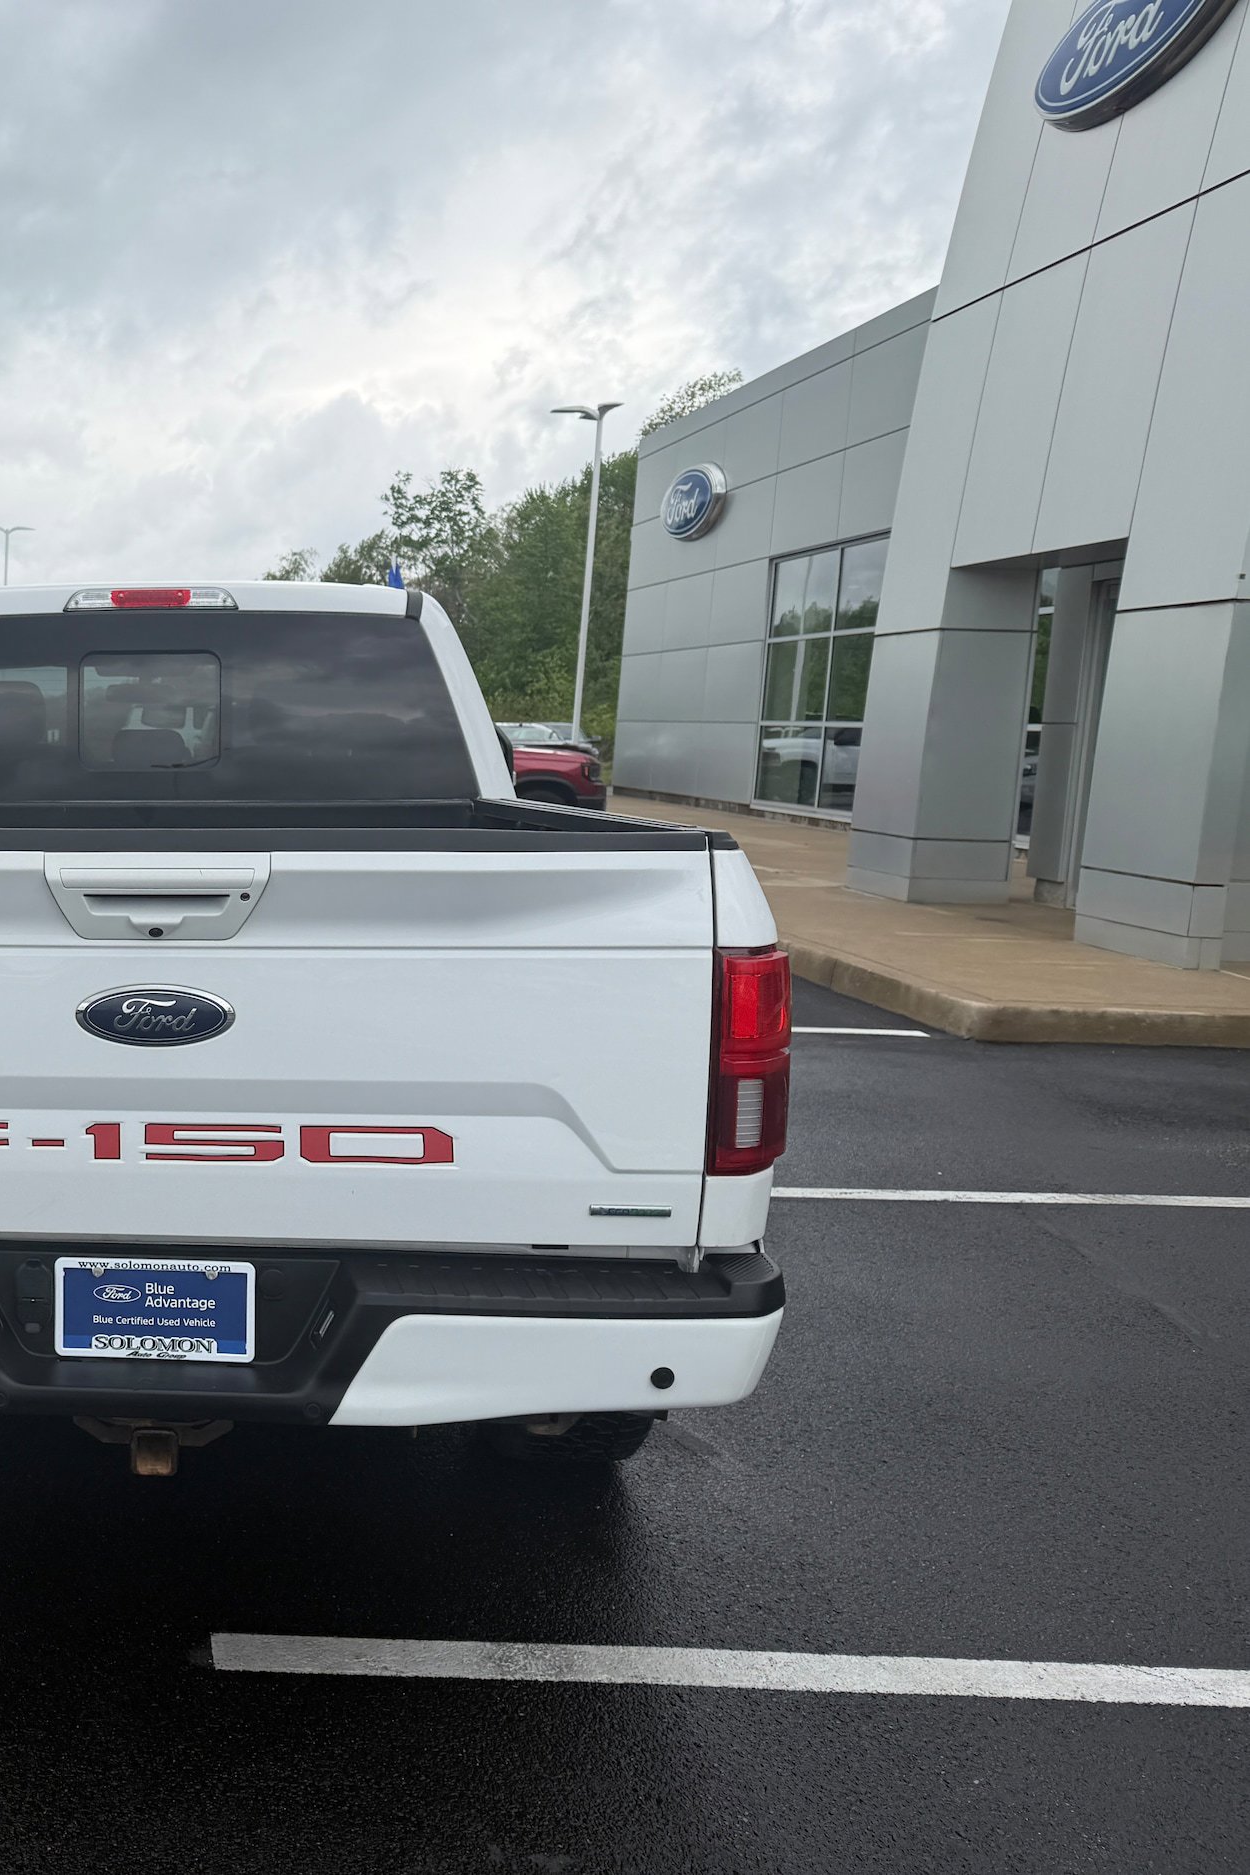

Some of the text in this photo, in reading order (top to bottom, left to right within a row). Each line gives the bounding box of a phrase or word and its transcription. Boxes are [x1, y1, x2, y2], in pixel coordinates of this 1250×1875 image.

[1059, 0, 1164, 96] Ford
[666, 481, 700, 525] Ford
[113, 998, 198, 1032] Ford
[78, 1260, 231, 1272] www.solomonauto.com
[102, 1286, 133, 1300] Ford
[145, 1282, 175, 1295] Blue
[145, 1296, 216, 1311] Advantage
[92, 1315, 216, 1328] Blue Certified Used Vehicle
[94, 1336, 214, 1353] SOLOMON
